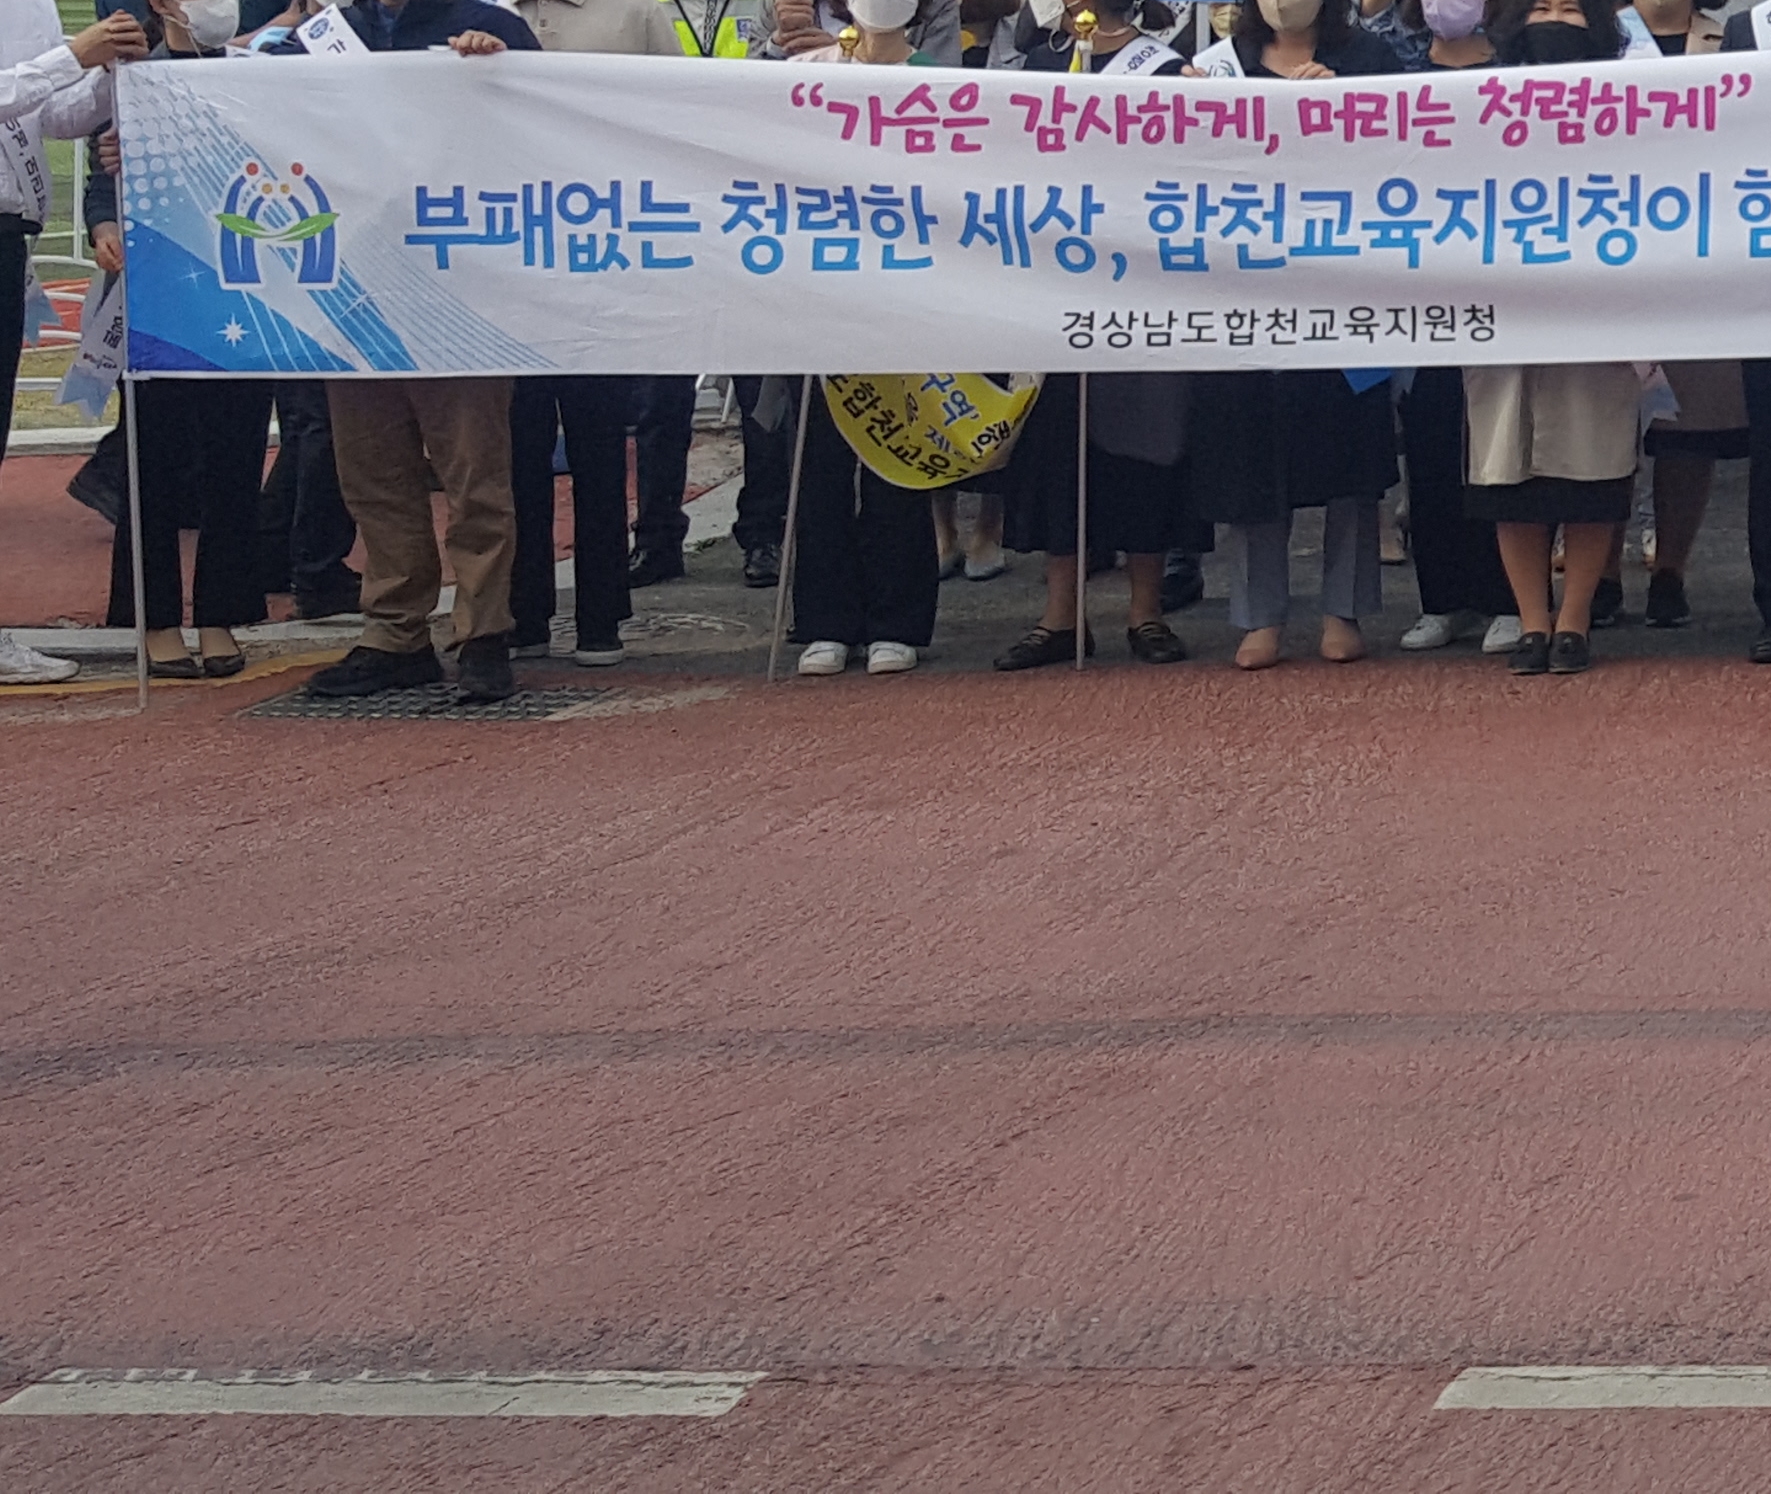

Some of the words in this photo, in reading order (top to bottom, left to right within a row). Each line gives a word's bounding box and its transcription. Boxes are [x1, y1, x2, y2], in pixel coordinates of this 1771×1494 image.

[790, 81, 991, 155] “가슴은
[1009, 85, 1282, 156] 감사하게,
[1297, 83, 1457, 148] 머리는
[1478, 73, 1752, 148] 청렴하게”
[405, 178, 701, 274] 부패없는
[720, 179, 938, 275] 청렴한
[957, 181, 1128, 281] 세상,
[1144, 171, 1712, 274] 합천교육지원청이
[1060, 303, 1498, 349] 경상남도합천교육지원청
